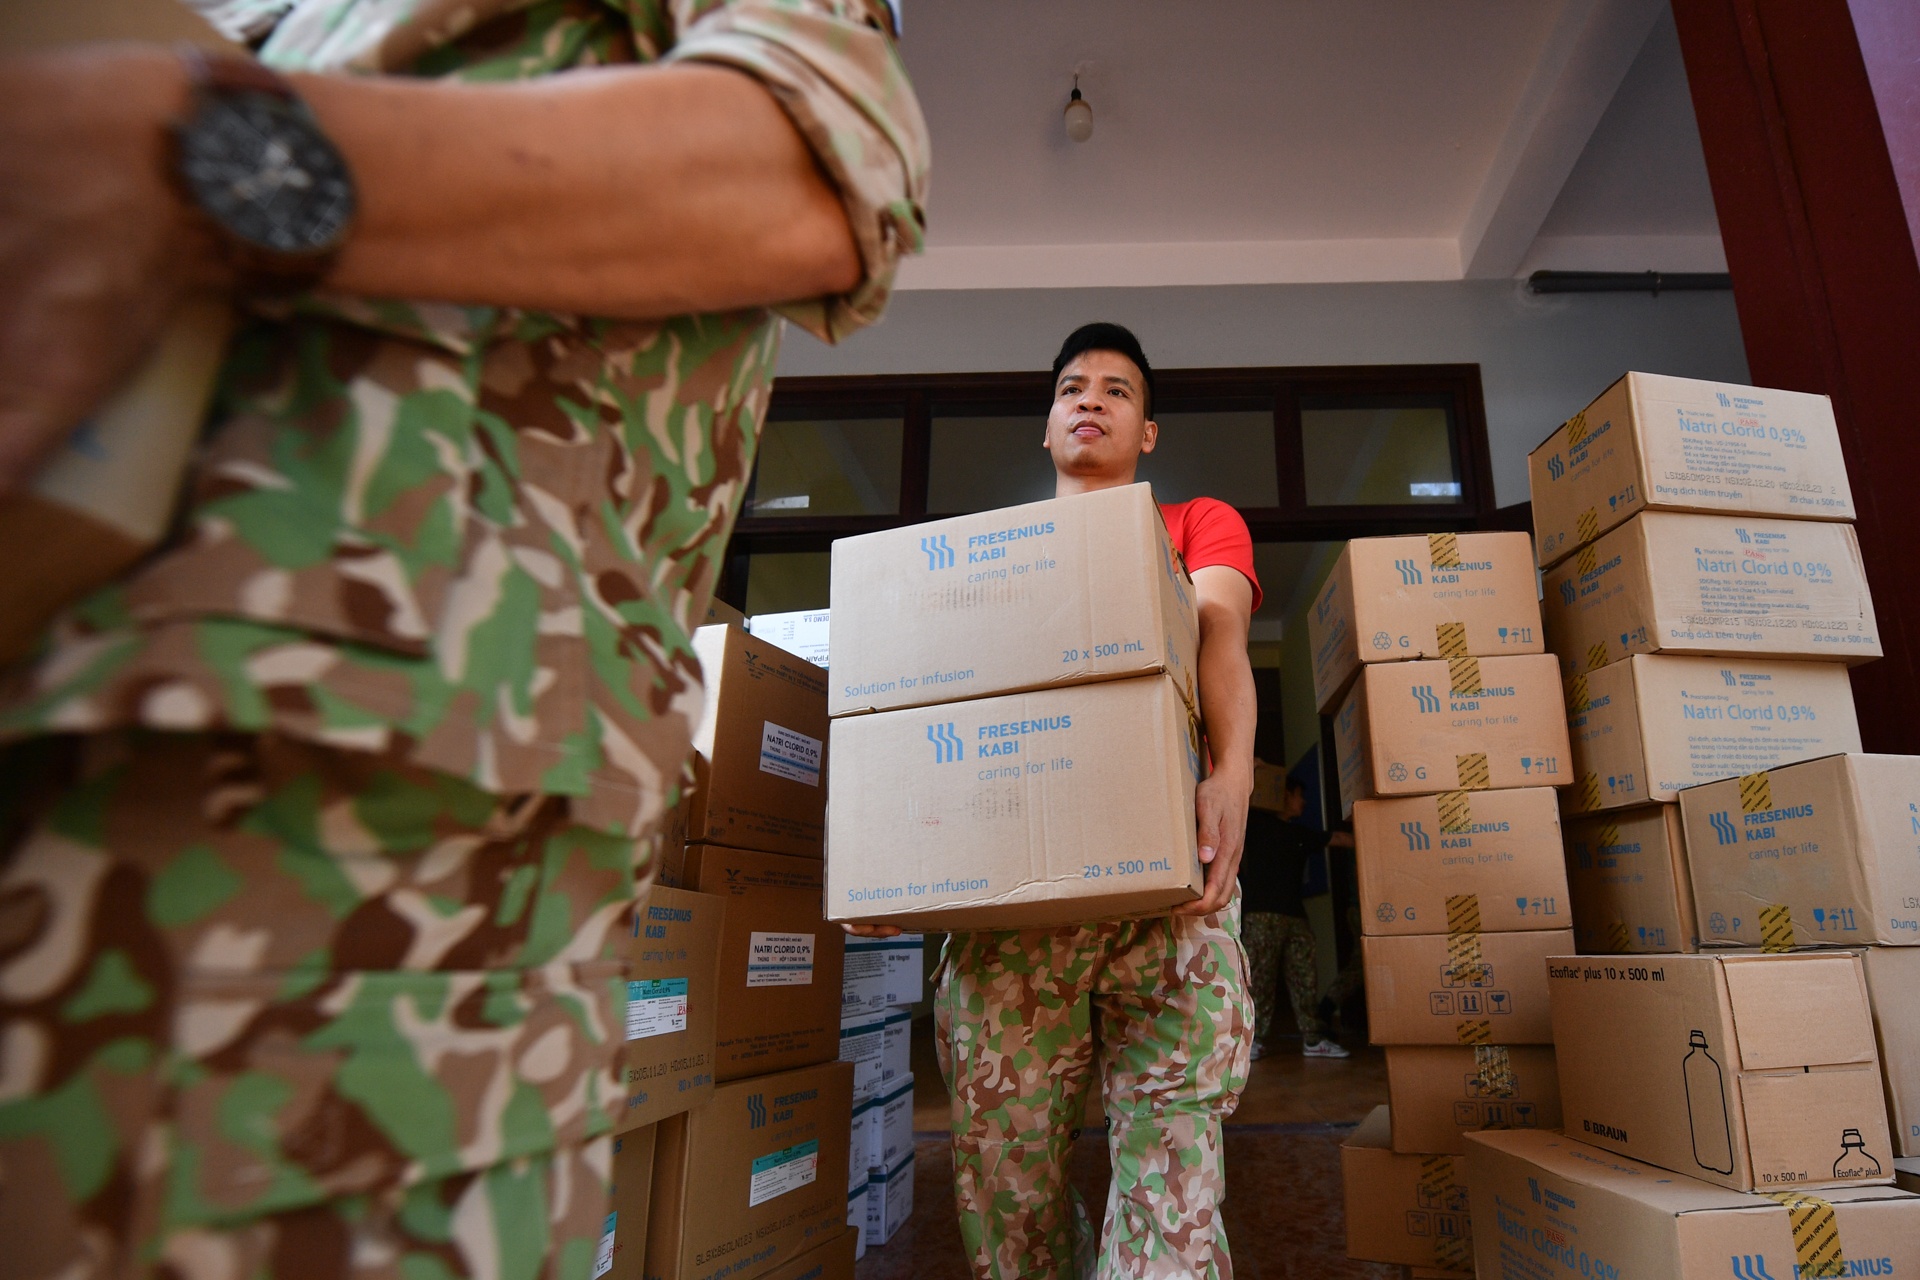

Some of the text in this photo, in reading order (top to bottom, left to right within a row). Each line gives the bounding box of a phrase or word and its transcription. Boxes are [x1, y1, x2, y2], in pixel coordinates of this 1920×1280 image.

[1680, 418, 1805, 443] Natri Clorid 0,9%
[1569, 421, 1611, 457] FRESENIUS
[1570, 451, 1589, 468] KABI
[1656, 485, 1677, 495] Dung
[1680, 487, 1697, 496] dịch
[1799, 496, 1814, 504] chai
[1821, 498, 1834, 506] 500
[969, 522, 1055, 548] FRESENIUS
[1559, 533, 1564, 543] P
[968, 547, 1005, 564] KABI
[1745, 550, 1765, 559] PASS
[968, 559, 1056, 583] caring for life
[1580, 555, 1622, 585] FRESENIUS
[1697, 558, 1832, 578] Natri Clorid 0,9%
[1432, 575, 1459, 584] KABI
[1434, 590, 1462, 598] caring
[1482, 588, 1496, 596] life
[1581, 581, 1600, 597] KABI
[1858, 623, 1863, 631] 2
[1399, 636, 1409, 647] G
[1671, 630, 1694, 639] Dung
[1813, 634, 1822, 642] 20
[1824, 635, 1839, 643] chai
[1847, 635, 1861, 644] 500
[1063, 640, 1144, 662] 20 x 500 mL
[845, 669, 974, 697] Solution for infusion
[1740, 673, 1771, 681] FRESENIUS
[1451, 702, 1479, 711] KABI
[1684, 704, 1815, 722] Natri Clorid 0,9%
[978, 715, 1071, 739] FRESENIUS
[1452, 718, 1482, 727] caring
[1503, 715, 1518, 724] life
[767, 734, 818, 758] NATRI CLORID 0,9%
[978, 740, 1018, 758] KABI
[978, 758, 1073, 780] caring for life
[1416, 767, 1426, 779] G
[1660, 782, 1693, 790] Solution
[1744, 805, 1813, 825] FRESENIUS
[1746, 827, 1775, 841] KABI
[1441, 838, 1471, 849] KABI
[1749, 843, 1819, 860] caring for life
[1442, 853, 1513, 865] caring for life
[1083, 858, 1171, 879] 20 x 500 mL
[848, 877, 988, 902] Solution for infusion
[648, 906, 692, 922] FRESENIUS
[1405, 908, 1416, 920] G
[1733, 918, 1741, 932] P
[1891, 918, 1917, 930] Dung
[646, 925, 666, 938] KABI
[643, 950, 663, 963] caring
[755, 945, 772, 953] NATRI
[797, 946, 810, 954] 0,9%
[1584, 969, 1601, 982] plus
[1604, 968, 1616, 979] 10
[1620, 971, 1625, 980] x
[1629, 968, 1648, 980] 500
[1652, 968, 1664, 981] ml
[679, 1074, 703, 1091] 80 100
[774, 1089, 817, 1107] FRESENIUS
[773, 1110, 793, 1123] KABI
[1593, 1121, 1627, 1143] BRAUN
[1763, 1174, 1771, 1182] 10
[1781, 1172, 1795, 1181] 500
[1799, 1171, 1807, 1179] ml
[1865, 1168, 1878, 1176] plus
[1544, 1188, 1575, 1208] FRESENIUS
[1545, 1200, 1559, 1212] KABI
[1800, 1203, 1821, 1226] Fresenius
[1546, 1228, 1565, 1245] PASS
[1813, 1223, 1824, 1236] Kabi
[1496, 1210, 1527, 1243] Natri
[1532, 1228, 1575, 1269] Clorid
[1796, 1234, 1815, 1252] Vietnam
[1809, 1249, 1820, 1263] Kabi
[1793, 1257, 1893, 1280] FRESENIUS
